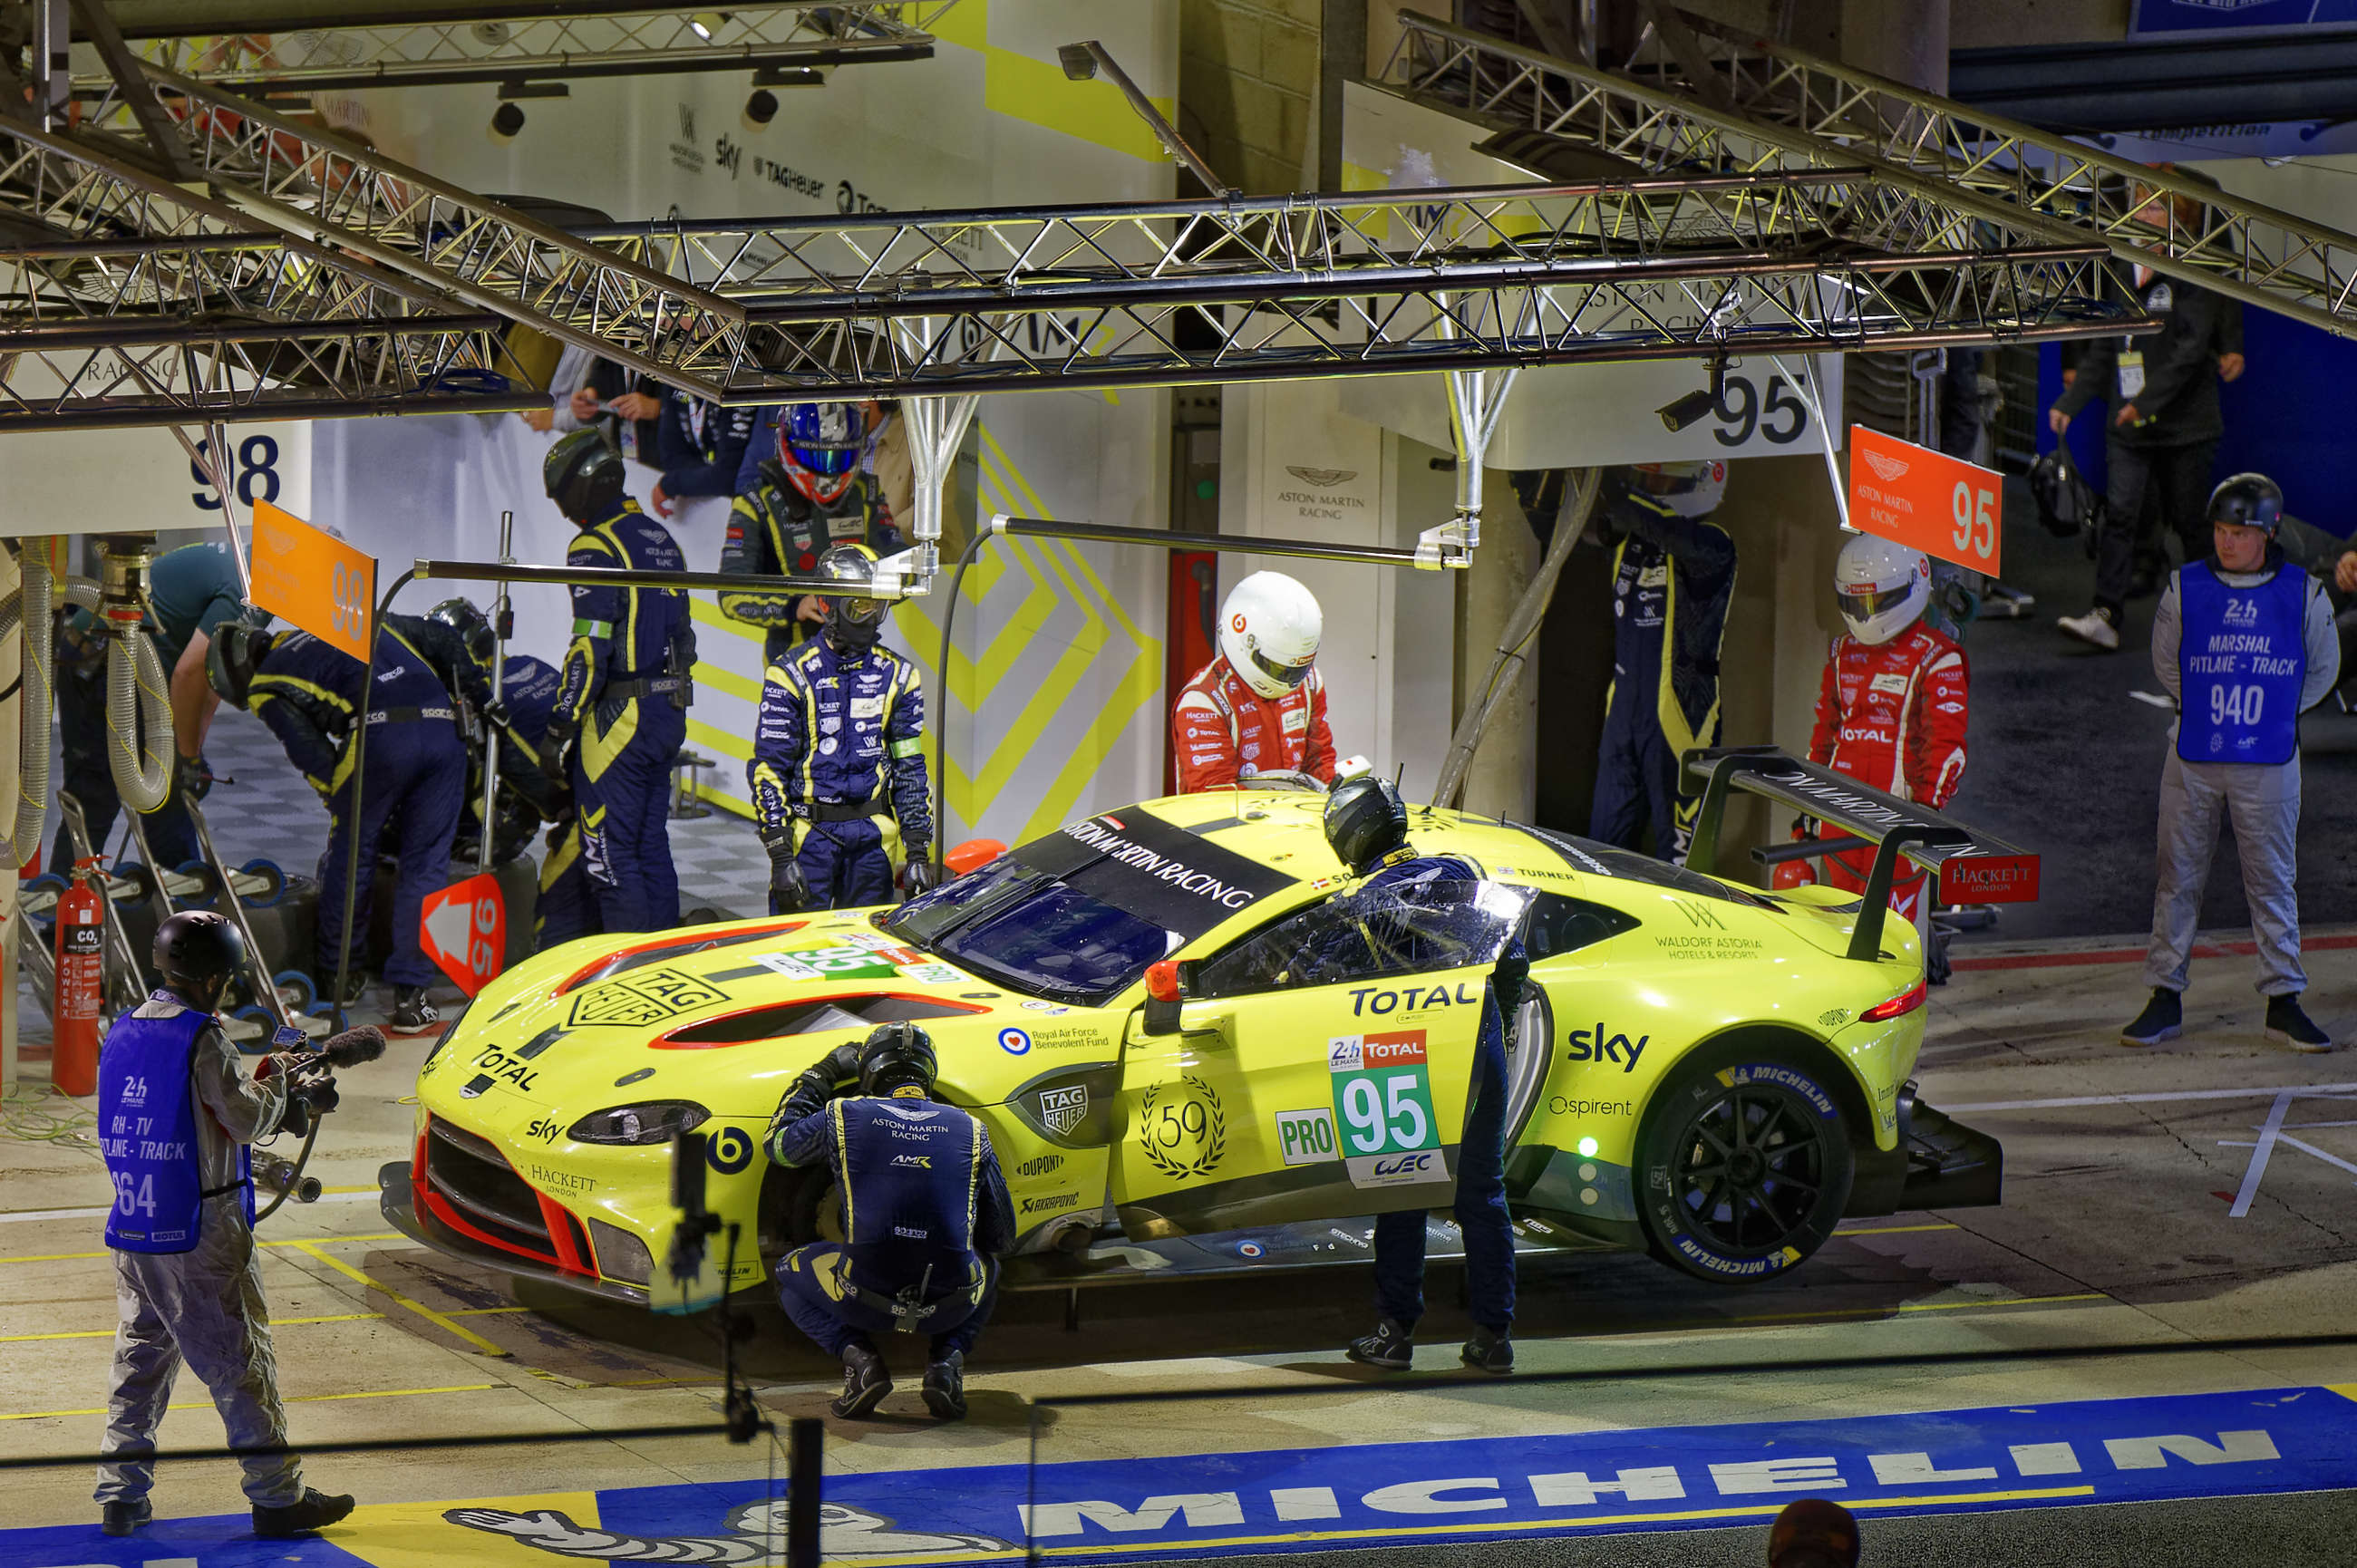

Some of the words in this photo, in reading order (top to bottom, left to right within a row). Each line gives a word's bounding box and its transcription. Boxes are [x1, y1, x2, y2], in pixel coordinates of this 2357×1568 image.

[715, 132, 742, 180] sky
[1575, 283, 1665, 309] ASTON
[1679, 277, 1783, 303] MATIN
[1713, 373, 1807, 447] 95
[190, 435, 279, 510] 98
[1277, 492, 1314, 504] ASTON
[1319, 496, 1364, 508] MARTIN
[1857, 485, 1882, 504] ASTON
[1884, 491, 1914, 514] MARTIN
[1298, 507, 1342, 520] RACING
[1870, 508, 1899, 528] RACING
[1953, 480, 1994, 559] 95
[331, 560, 364, 642] 98
[2208, 634, 2271, 654] MARSHAL
[2190, 655, 2237, 674] PITLANE
[2252, 656, 2300, 676] TRACK
[2210, 684, 2265, 726] 940
[1154, 861, 1255, 909] RACING
[1517, 868, 1576, 882] TURNER
[1952, 866, 2031, 885] HACKETT
[1971, 883, 2012, 892] LONDON
[472, 898, 497, 977] 95
[1655, 936, 1712, 949] WALDORF
[1716, 937, 1763, 949] ASTORIA
[791, 946, 888, 972] 95
[882, 948, 915, 965] TOTAL
[1669, 951, 1706, 960] HOTELS
[1707, 952, 1714, 960] &
[1716, 951, 1760, 961] RESORTS
[910, 964, 961, 982] PRO
[635, 972, 713, 1007] TAG
[1349, 982, 1478, 1018] TOTAL
[580, 983, 663, 1022] HEUER
[1032, 1030, 1059, 1042] Royal
[1060, 1029, 1072, 1038] Air
[1072, 1027, 1100, 1038] Force
[1034, 1038, 1085, 1050] Benevolent
[1087, 1036, 1110, 1048] Fund
[1365, 1042, 1424, 1059] TOTAL
[1567, 1022, 1650, 1073] sky
[470, 1043, 540, 1092] TOTAL
[1044, 1089, 1084, 1109] TAG
[1752, 1066, 1834, 1114] MICHELIN
[1046, 1108, 1086, 1132] HEUER
[1343, 1074, 1428, 1154] 95
[1568, 1098, 1633, 1120] spirent
[112, 1115, 127, 1135] RH
[136, 1117, 153, 1137] TV
[526, 1118, 566, 1145] sky
[871, 1117, 906, 1130] ASTON
[909, 1124, 949, 1134] MARTIN
[1157, 1100, 1207, 1148] 59
[891, 1129, 930, 1142] RACING
[1281, 1118, 1334, 1157] PRO
[139, 1140, 187, 1161] TRACK
[892, 1154, 933, 1169] AMR
[1023, 1155, 1060, 1176] DUPONT
[1372, 1154, 1431, 1176] WEC
[531, 1164, 597, 1193] HACKETT
[546, 1185, 577, 1198] LONDON
[893, 1225, 927, 1239] sparco
[1680, 1239, 1766, 1274] MICHELIN
[890, 1304, 936, 1317] spco
[1018, 1430, 2282, 1537] MICHELIN
